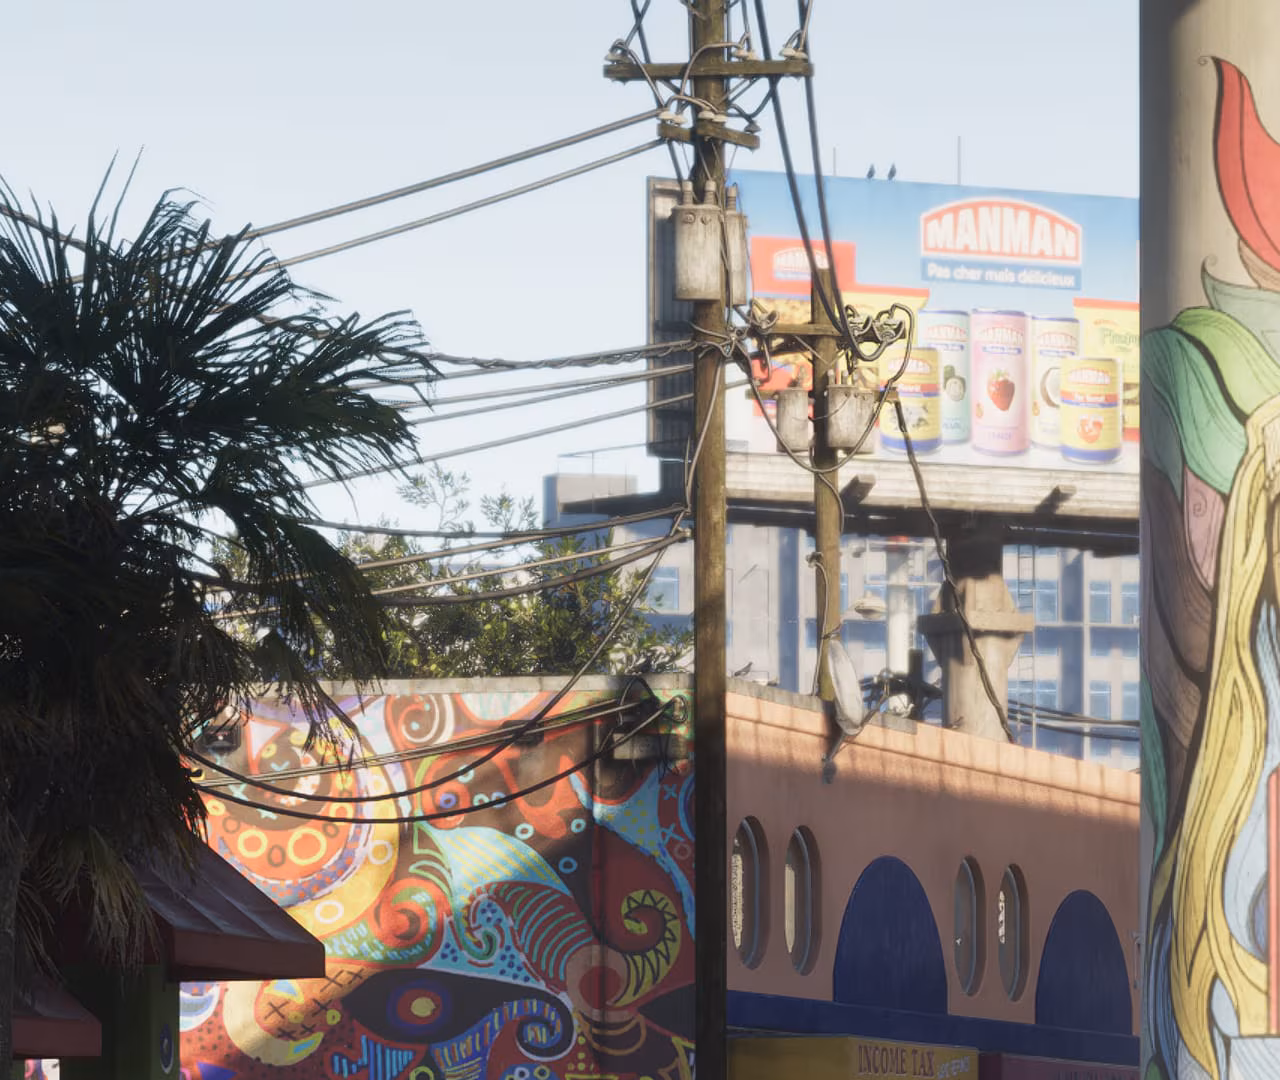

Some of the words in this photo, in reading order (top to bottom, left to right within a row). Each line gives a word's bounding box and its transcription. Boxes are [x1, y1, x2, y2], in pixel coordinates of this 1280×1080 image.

[927, 206, 1076, 257] MANMAN
[927, 262, 951, 279] Pas
[953, 264, 982, 282] cher
[985, 267, 1015, 284] mais
[857, 1044, 907, 1076] INCOME
[911, 1048, 935, 1078] TAX
